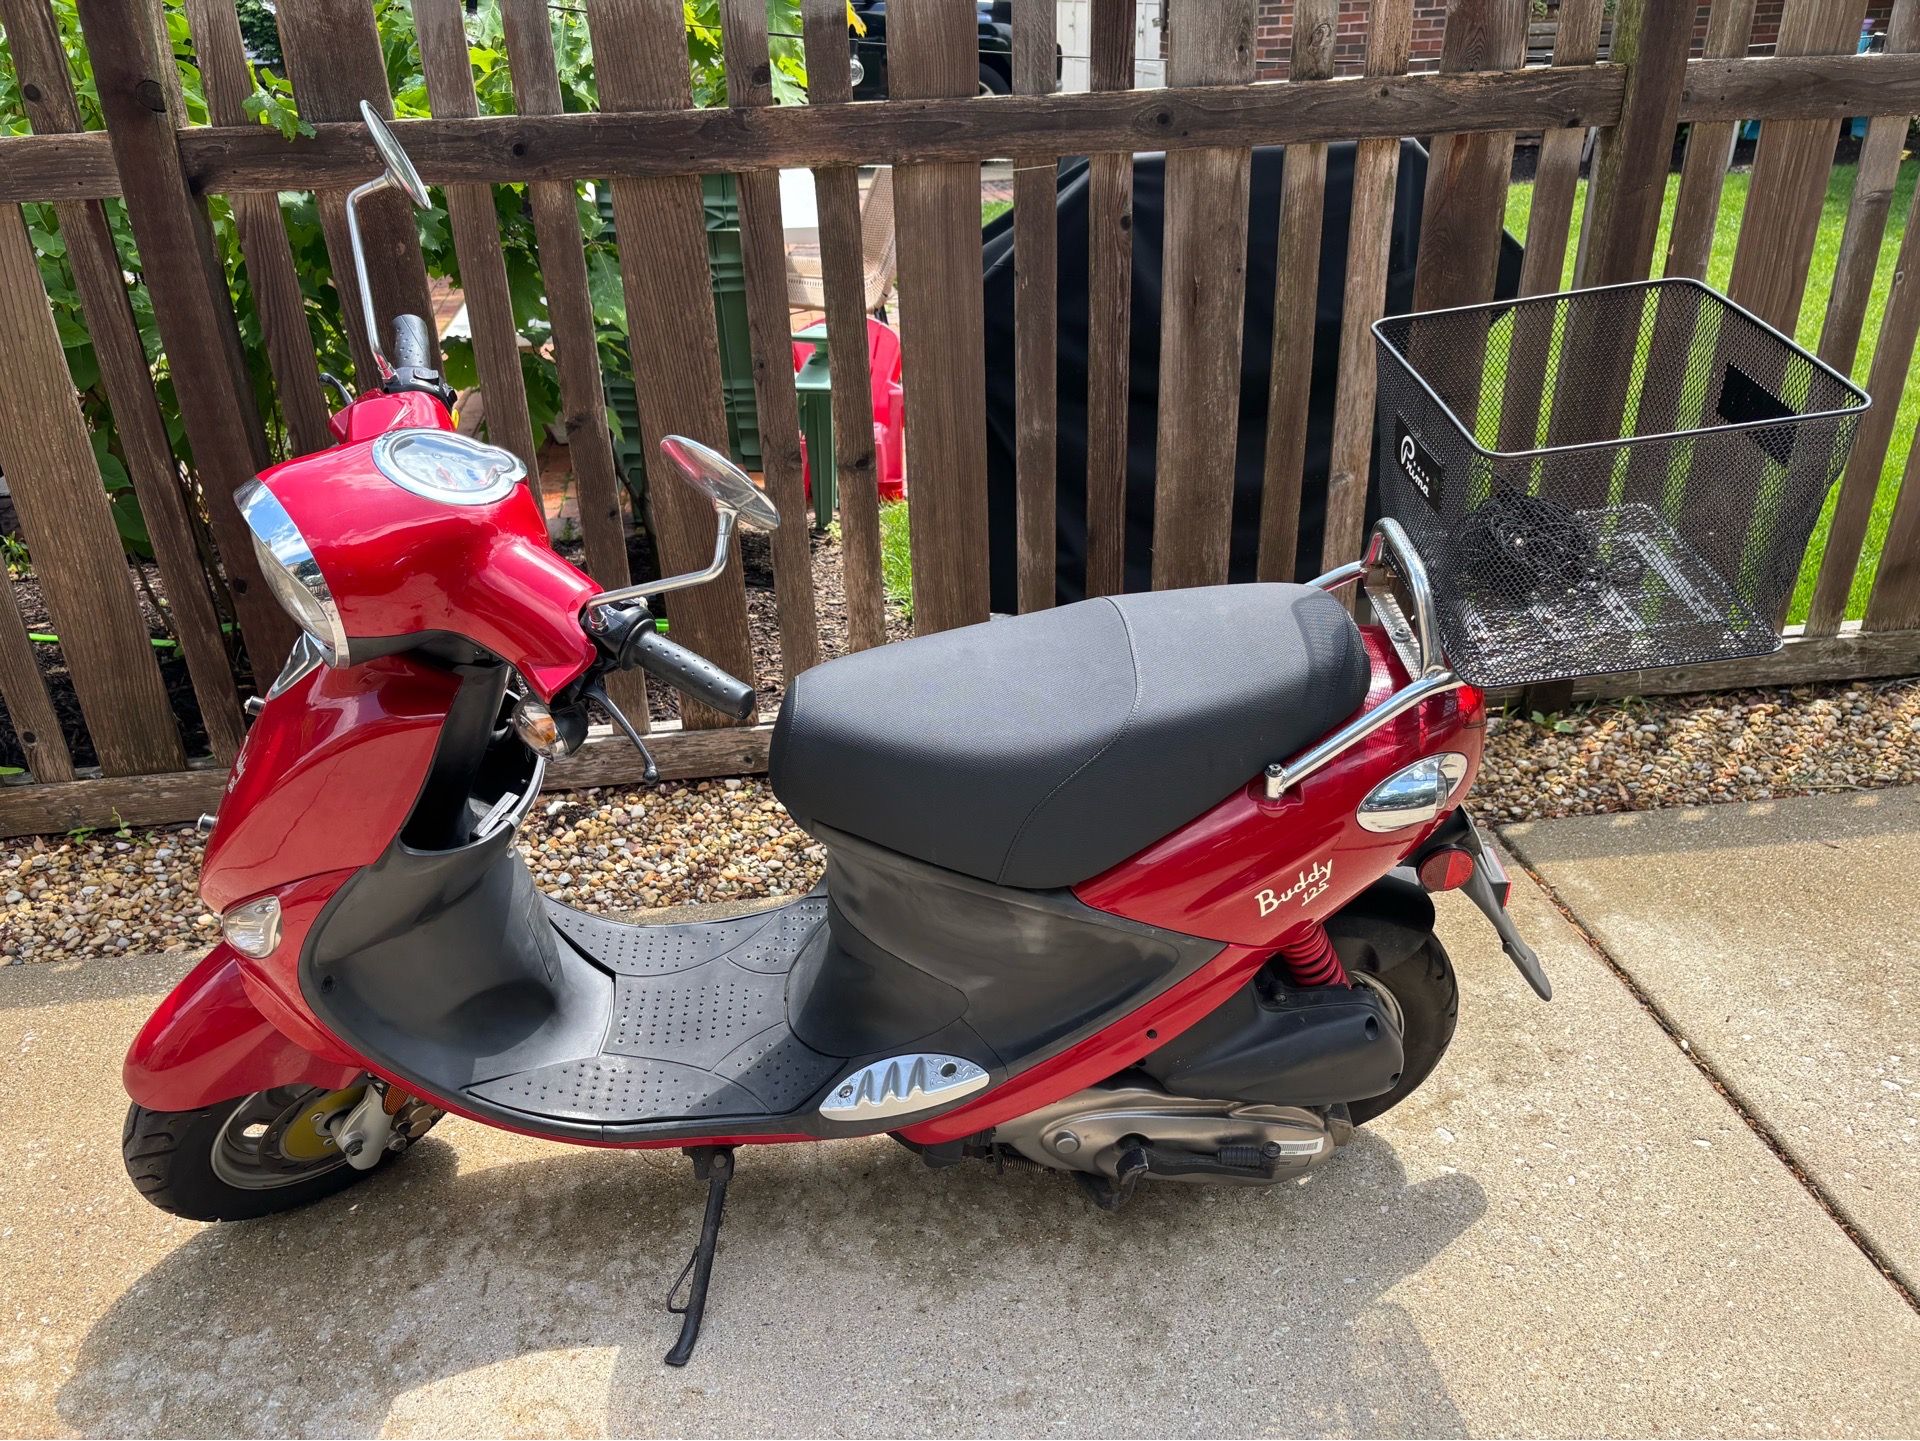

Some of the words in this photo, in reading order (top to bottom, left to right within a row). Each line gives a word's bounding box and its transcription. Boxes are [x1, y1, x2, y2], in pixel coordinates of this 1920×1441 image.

[1401, 435, 1429, 498] Prima
[1254, 859, 1333, 917] Buddy
[1301, 880, 1330, 907] 125
